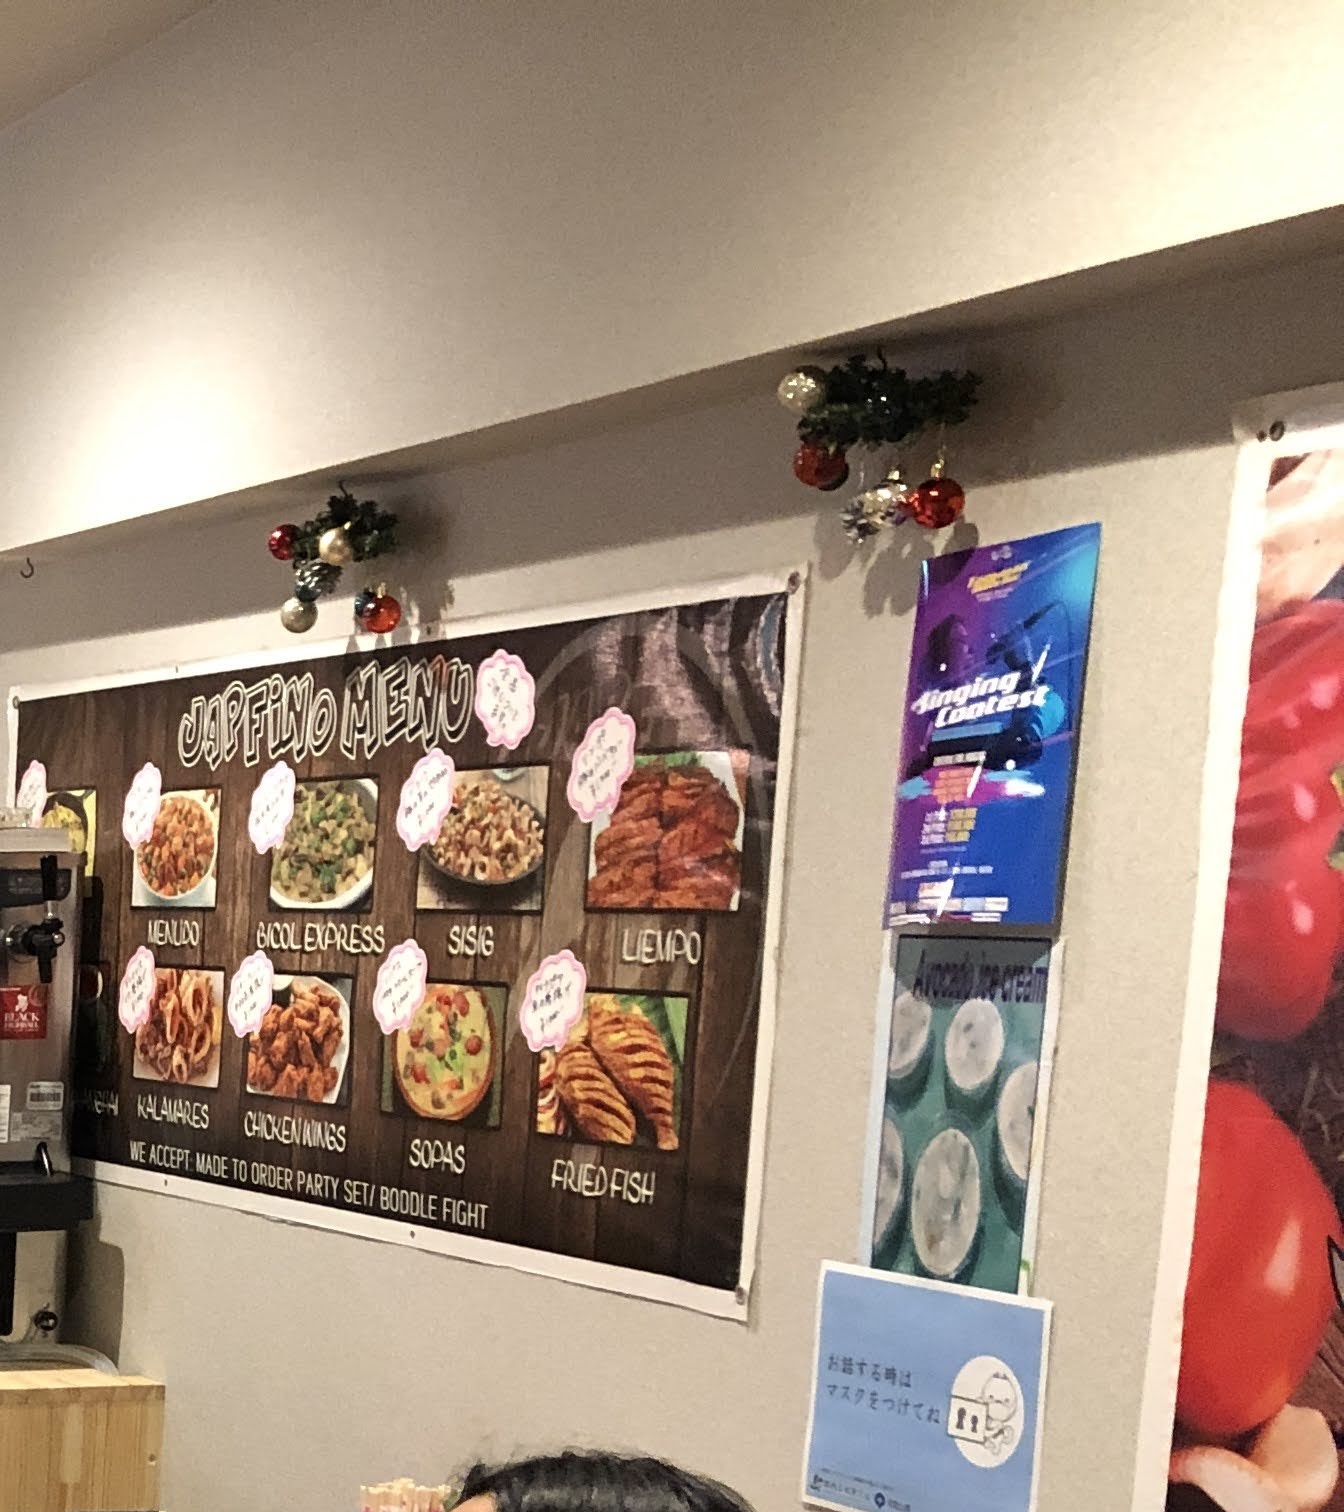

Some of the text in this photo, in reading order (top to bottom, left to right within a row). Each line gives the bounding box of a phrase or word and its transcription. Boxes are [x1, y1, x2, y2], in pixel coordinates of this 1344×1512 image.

[340, 654, 474, 760] MENU
[935, 685, 1050, 729] Contest
[147, 919, 201, 948] MENUDO
[256, 921, 386, 954] BICOL EXPRESS
[448, 924, 495, 957] SISIG
[622, 928, 702, 966] LIEMPO
[137, 1093, 210, 1130] KALAMARES
[244, 1110, 346, 1154] CHICKEN WINGS
[409, 1137, 466, 1175] SOPAS
[129, 1140, 147, 1164] WE
[195, 1153, 229, 1180] MADE
[231, 1159, 249, 1183] TO
[251, 1162, 293, 1192] ORDER
[296, 1170, 340, 1200] PARTY
[380, 1185, 438, 1220] BODDLE
[443, 1197, 489, 1231] FIGHT
[551, 1159, 656, 1205] FRIED FISH
[827, 1355, 912, 1388] お話する時は
[827, 1383, 941, 1425] マスクをつけてね
